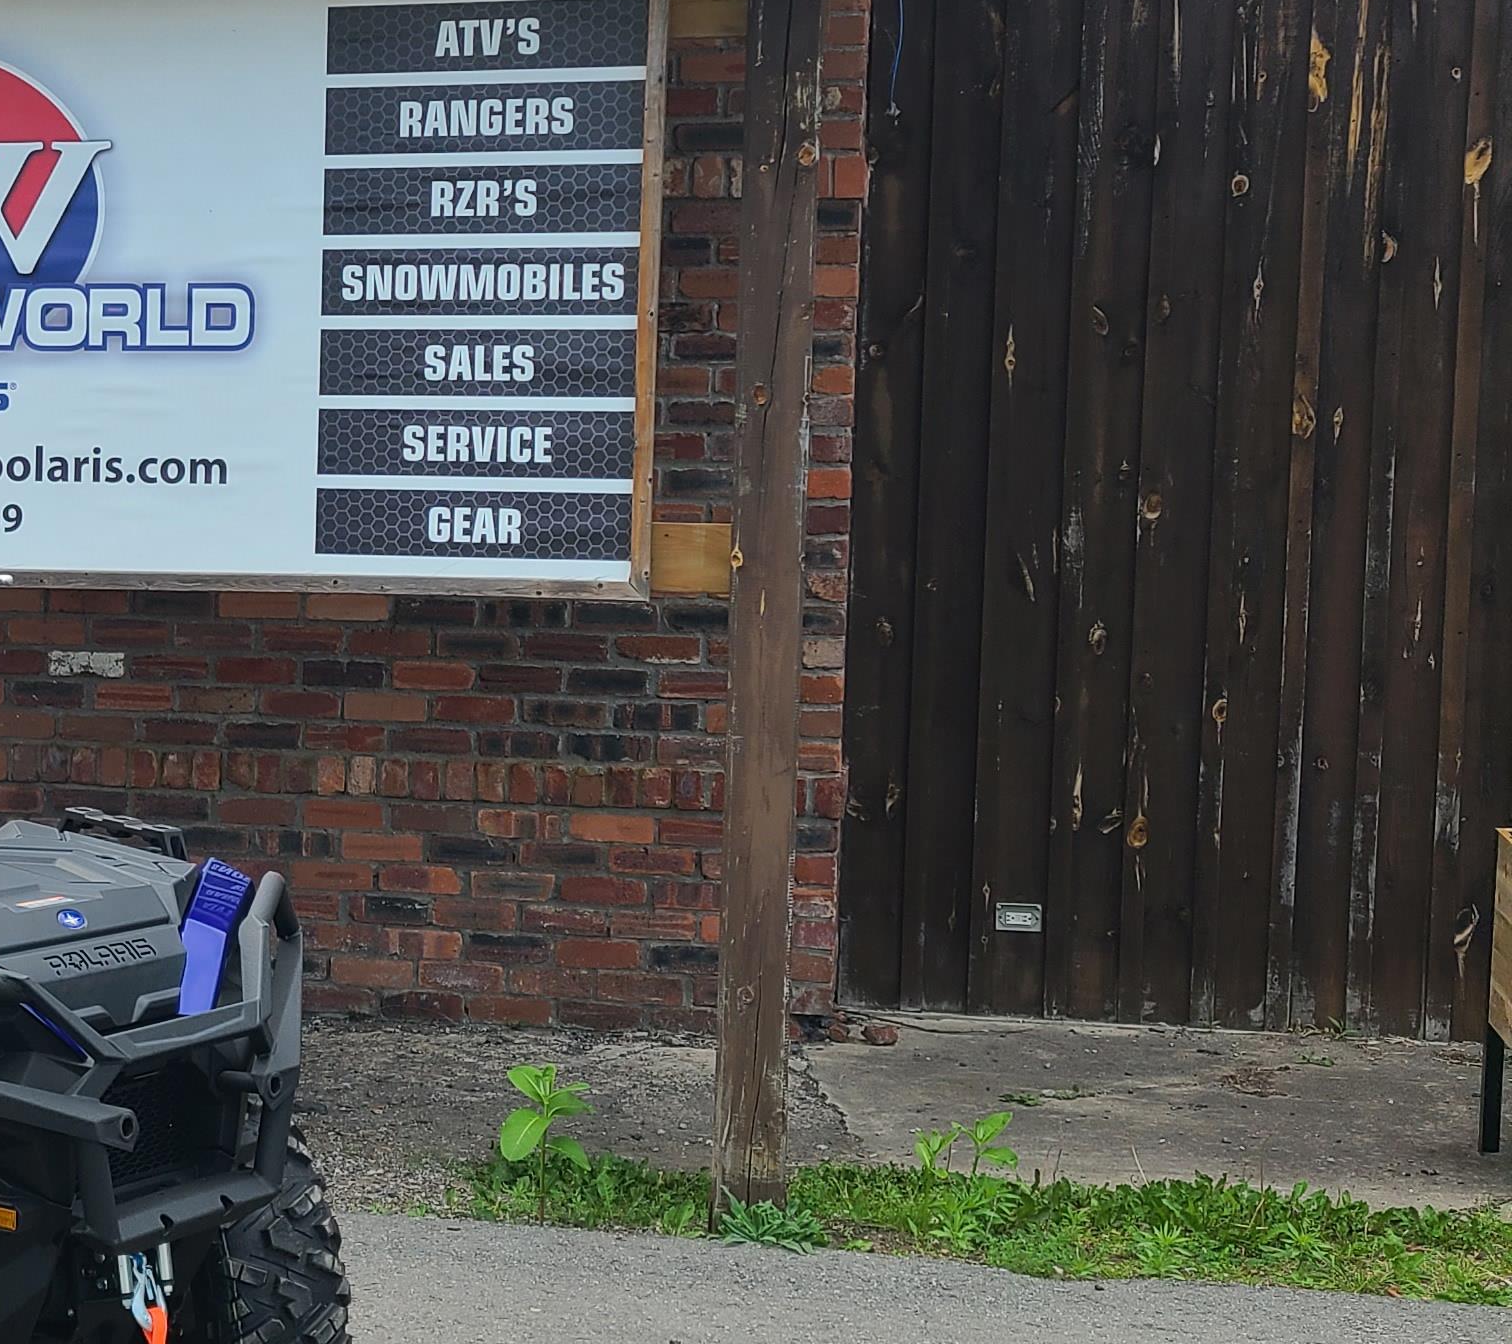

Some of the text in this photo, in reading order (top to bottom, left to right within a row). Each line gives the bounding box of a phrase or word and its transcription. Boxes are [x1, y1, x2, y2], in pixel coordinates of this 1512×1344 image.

[434, 16, 541, 58] ATV'S
[398, 96, 575, 139] RANGERS
[429, 178, 538, 218] RZR'S
[341, 262, 626, 302] SNOWMOBILES
[423, 343, 536, 383] SALES
[401, 424, 554, 464] SERVICE
[427, 506, 523, 545] GEAR
[42, 937, 157, 976] POLARIS
